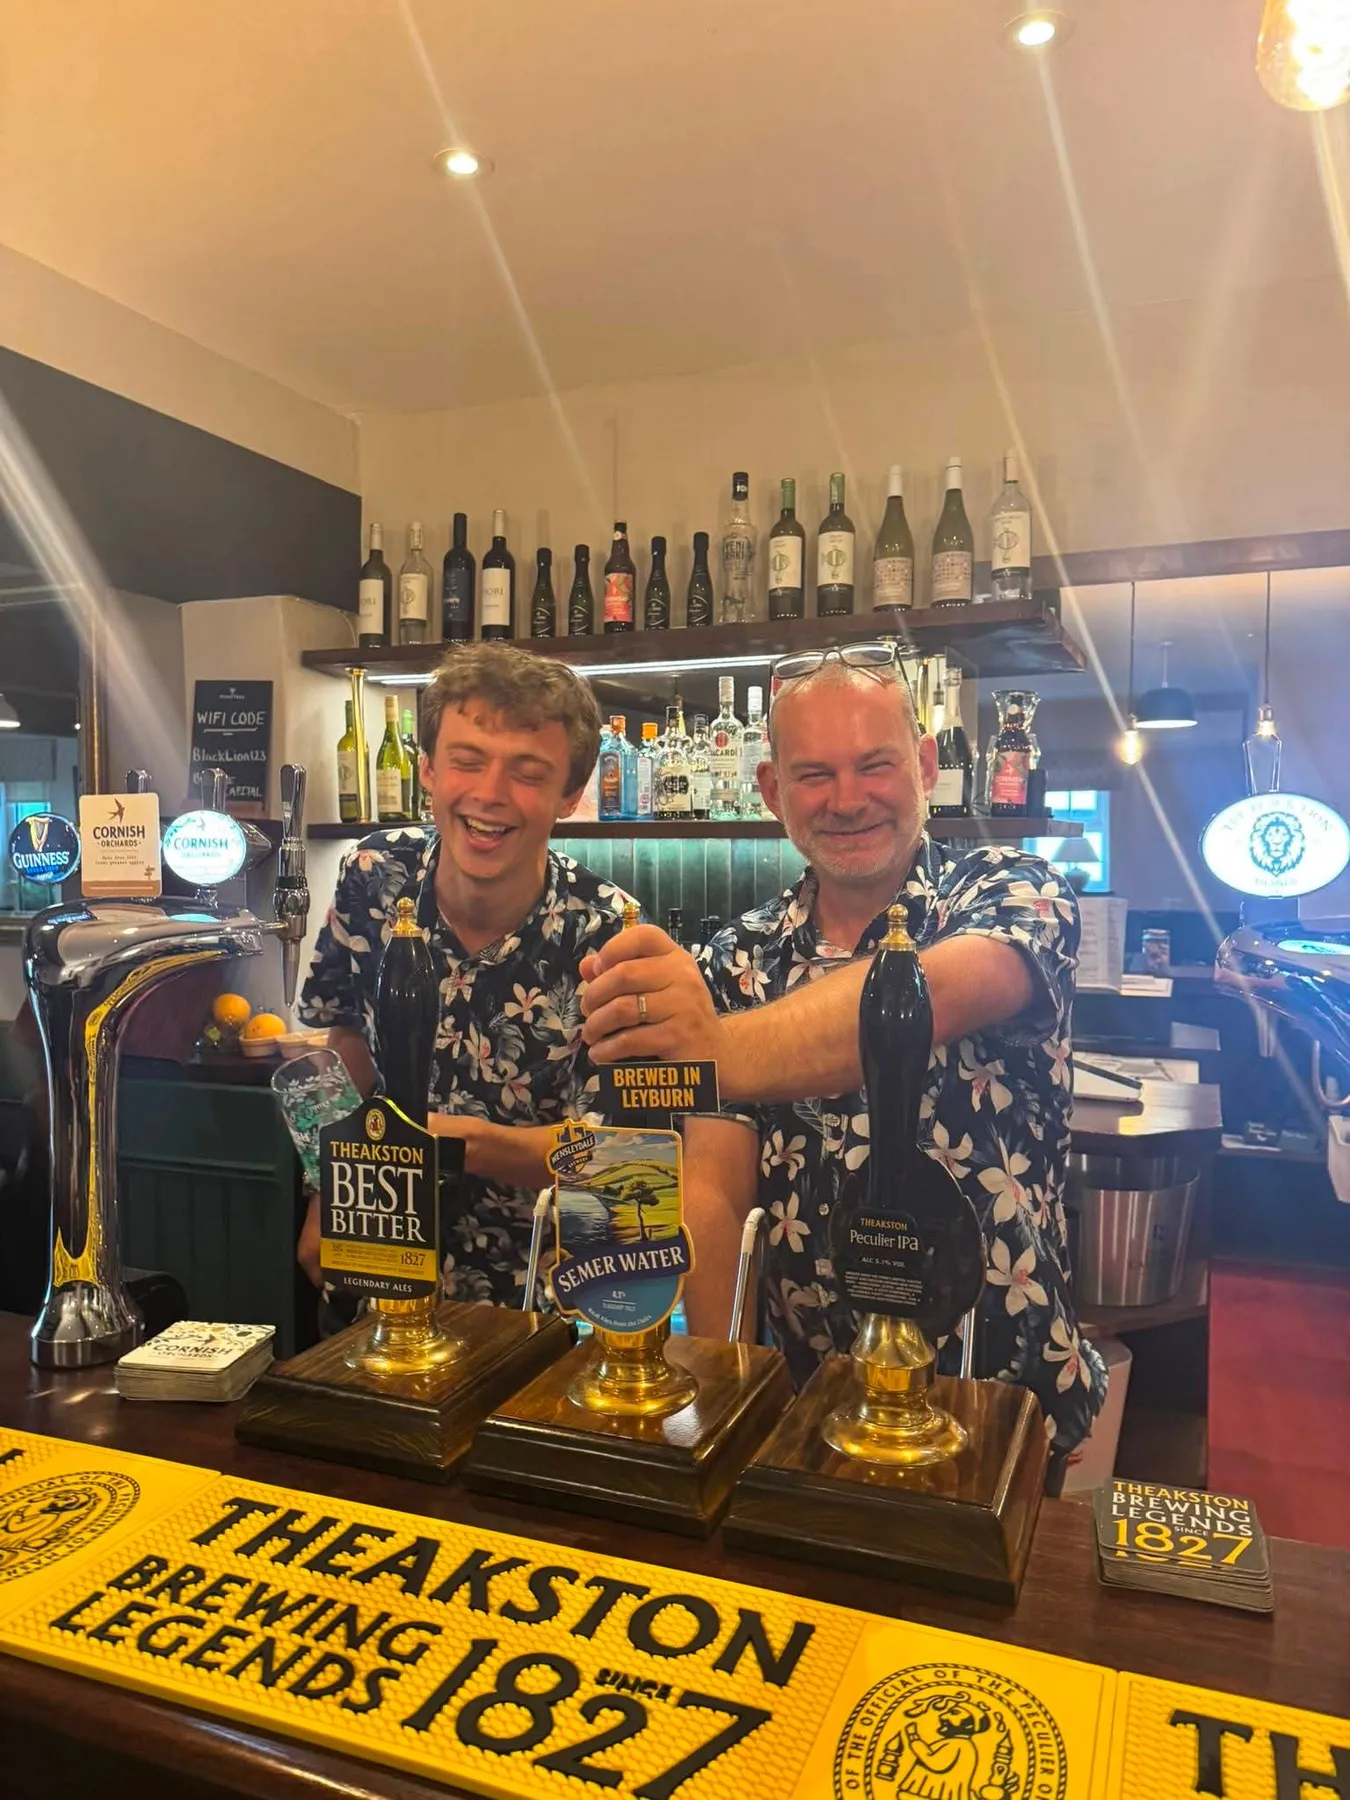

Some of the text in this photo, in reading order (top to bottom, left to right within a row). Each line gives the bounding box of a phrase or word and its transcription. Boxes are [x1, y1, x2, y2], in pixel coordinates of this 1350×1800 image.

[197, 710, 267, 726] WIFI CODE
[93, 825, 146, 840] CORNISH
[100, 839, 139, 848] ORCHARDS
[173, 837, 229, 850] CORNISH
[12, 851, 70, 869] GUINNESS
[613, 1066, 701, 1088] BREWED IN
[622, 1088, 695, 1109] LEYBURN
[329, 1141, 424, 1165] THEAKSTON
[551, 1135, 595, 1164] WENSLEYDALE
[330, 1161, 424, 1215] BEST
[330, 1208, 427, 1243] BITTER
[860, 1217, 908, 1232] THEAKSTON
[850, 1229, 895, 1249] Peculier
[400, 1251, 427, 1267] 1827
[557, 1245, 685, 1293] SEMER WATER
[343, 1276, 412, 1293] LEGENDARY ALES
[153, 1344, 234, 1355] CORNISH
[1113, 1481, 1249, 1511] THEAKSTON
[1113, 1491, 1250, 1523] BREWING
[1112, 1504, 1253, 1537] LEGENDS
[1174, 1525, 1208, 1537] SINCE
[1112, 1518, 1253, 1565] 1827
[190, 1497, 816, 1687] THEAKSTON
[106, 1553, 442, 1666] BREWING
[49, 1591, 401, 1715] LEGENDS
[594, 1667, 672, 1702] SINCE
[934, 1669, 961, 1680] OF
[975, 1674, 1018, 1699] THE
[862, 1674, 924, 1728] OFFICIAL
[401, 1638, 773, 1800] 1827
[848, 1733, 868, 1760] THE
[1020, 1702, 1056, 1775] PECULIER
[845, 1768, 860, 1790] OF
